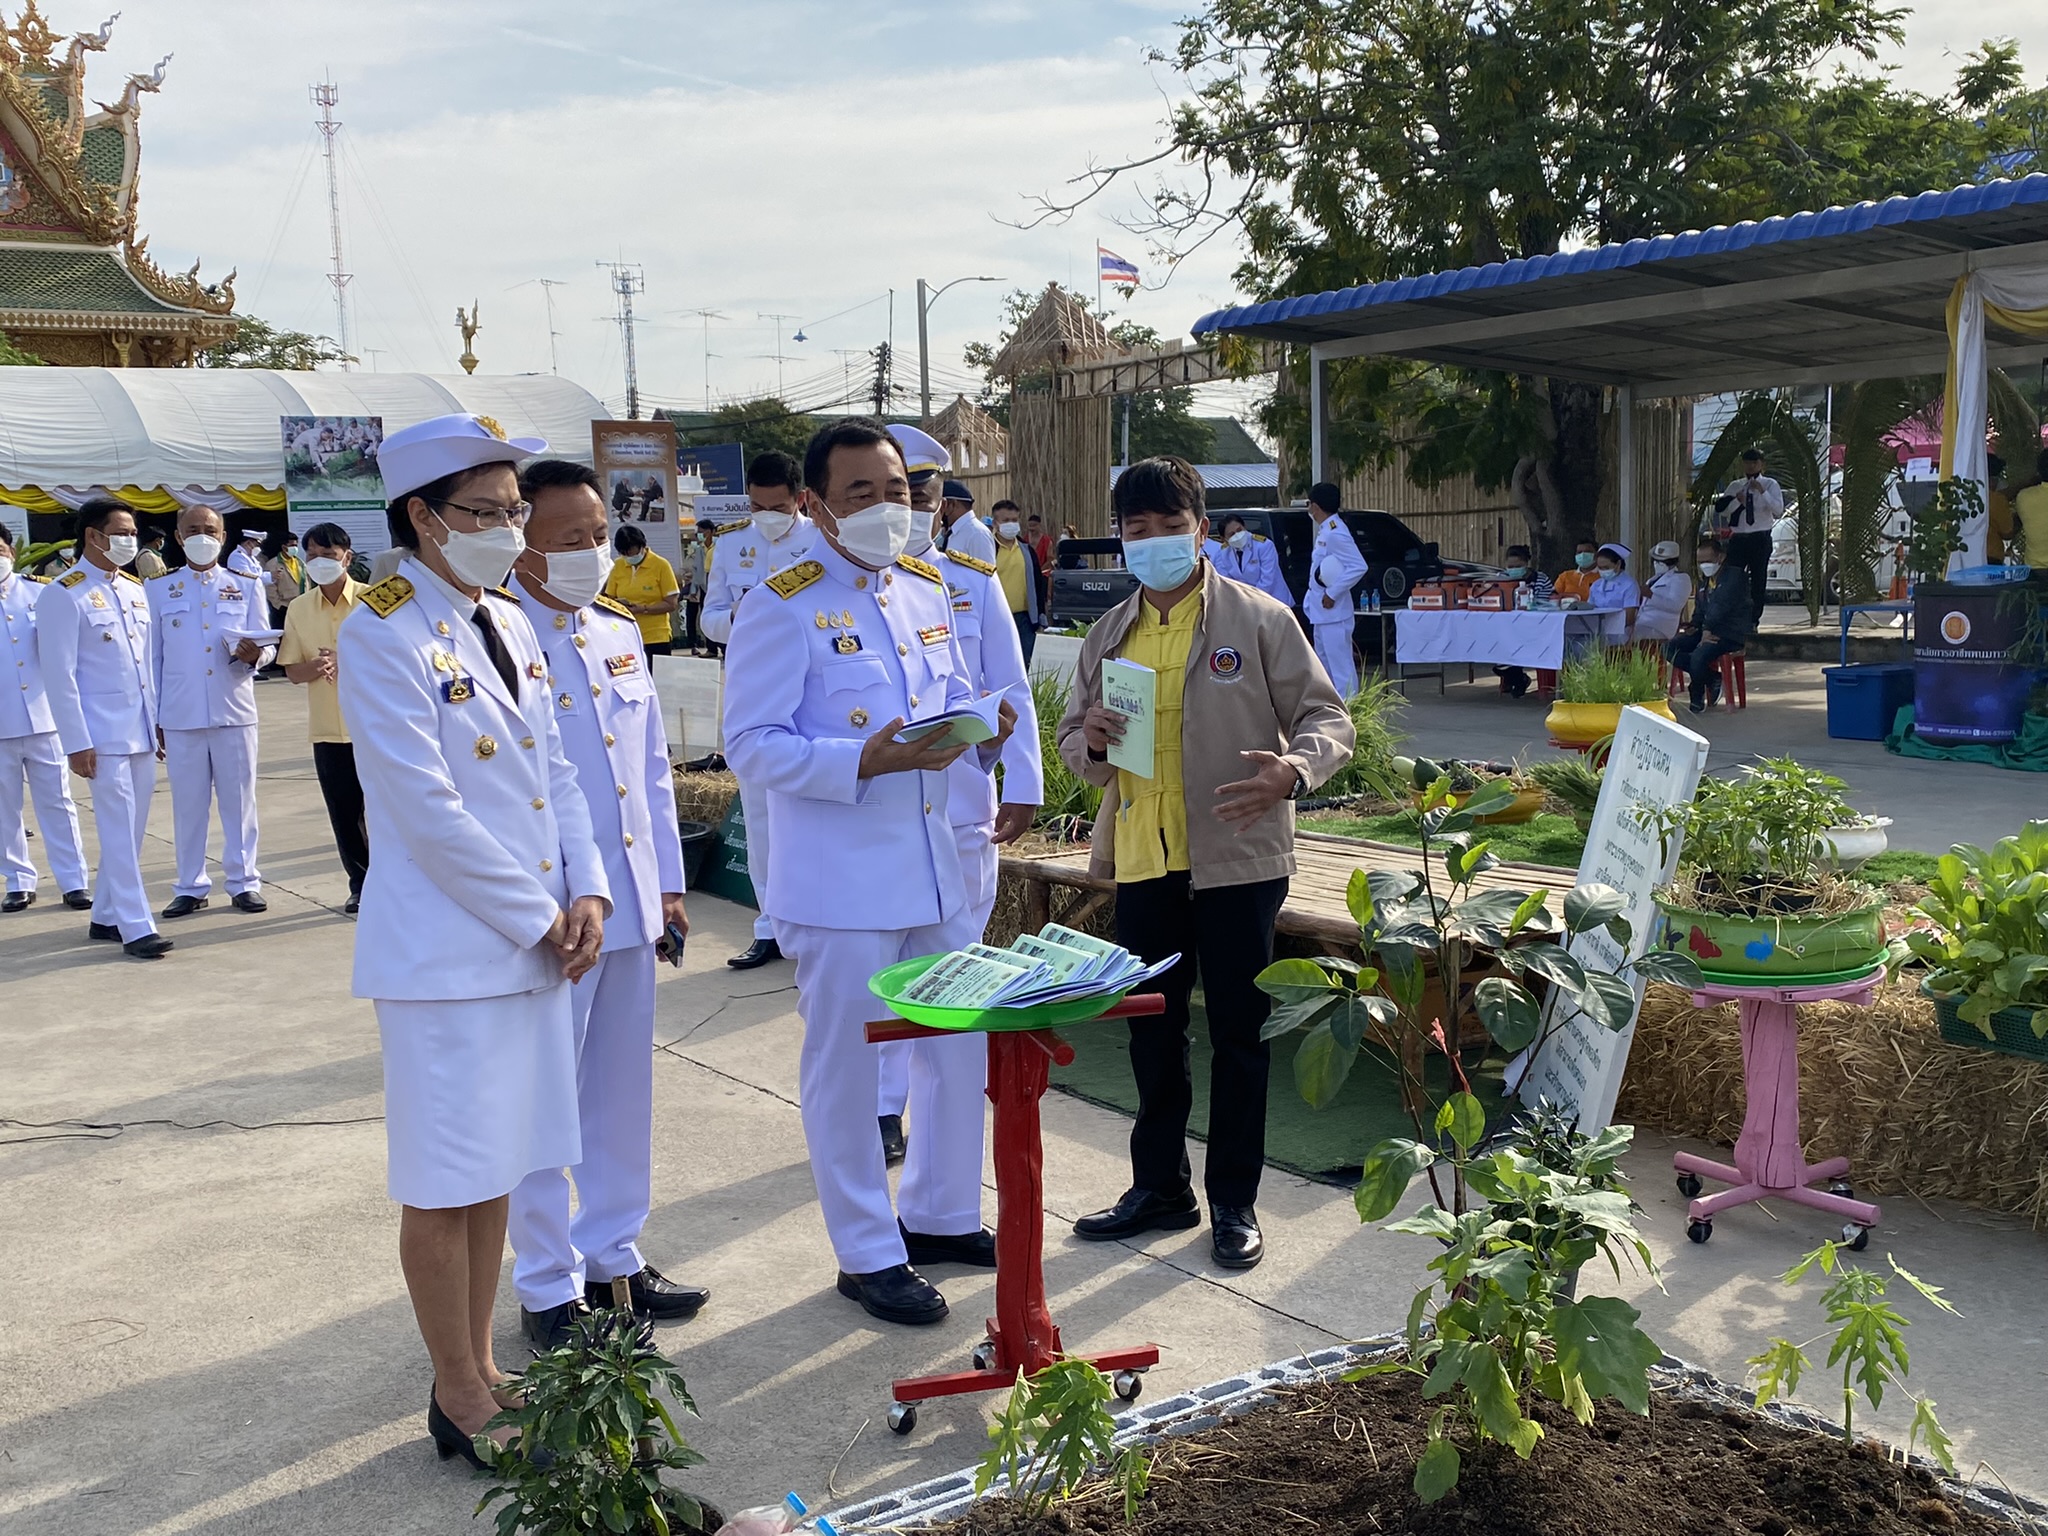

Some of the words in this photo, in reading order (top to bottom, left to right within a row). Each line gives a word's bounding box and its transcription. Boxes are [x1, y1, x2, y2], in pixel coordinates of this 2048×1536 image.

[724, 501, 751, 512] วันดินโล
[1082, 582, 1111, 591] ISUZU
